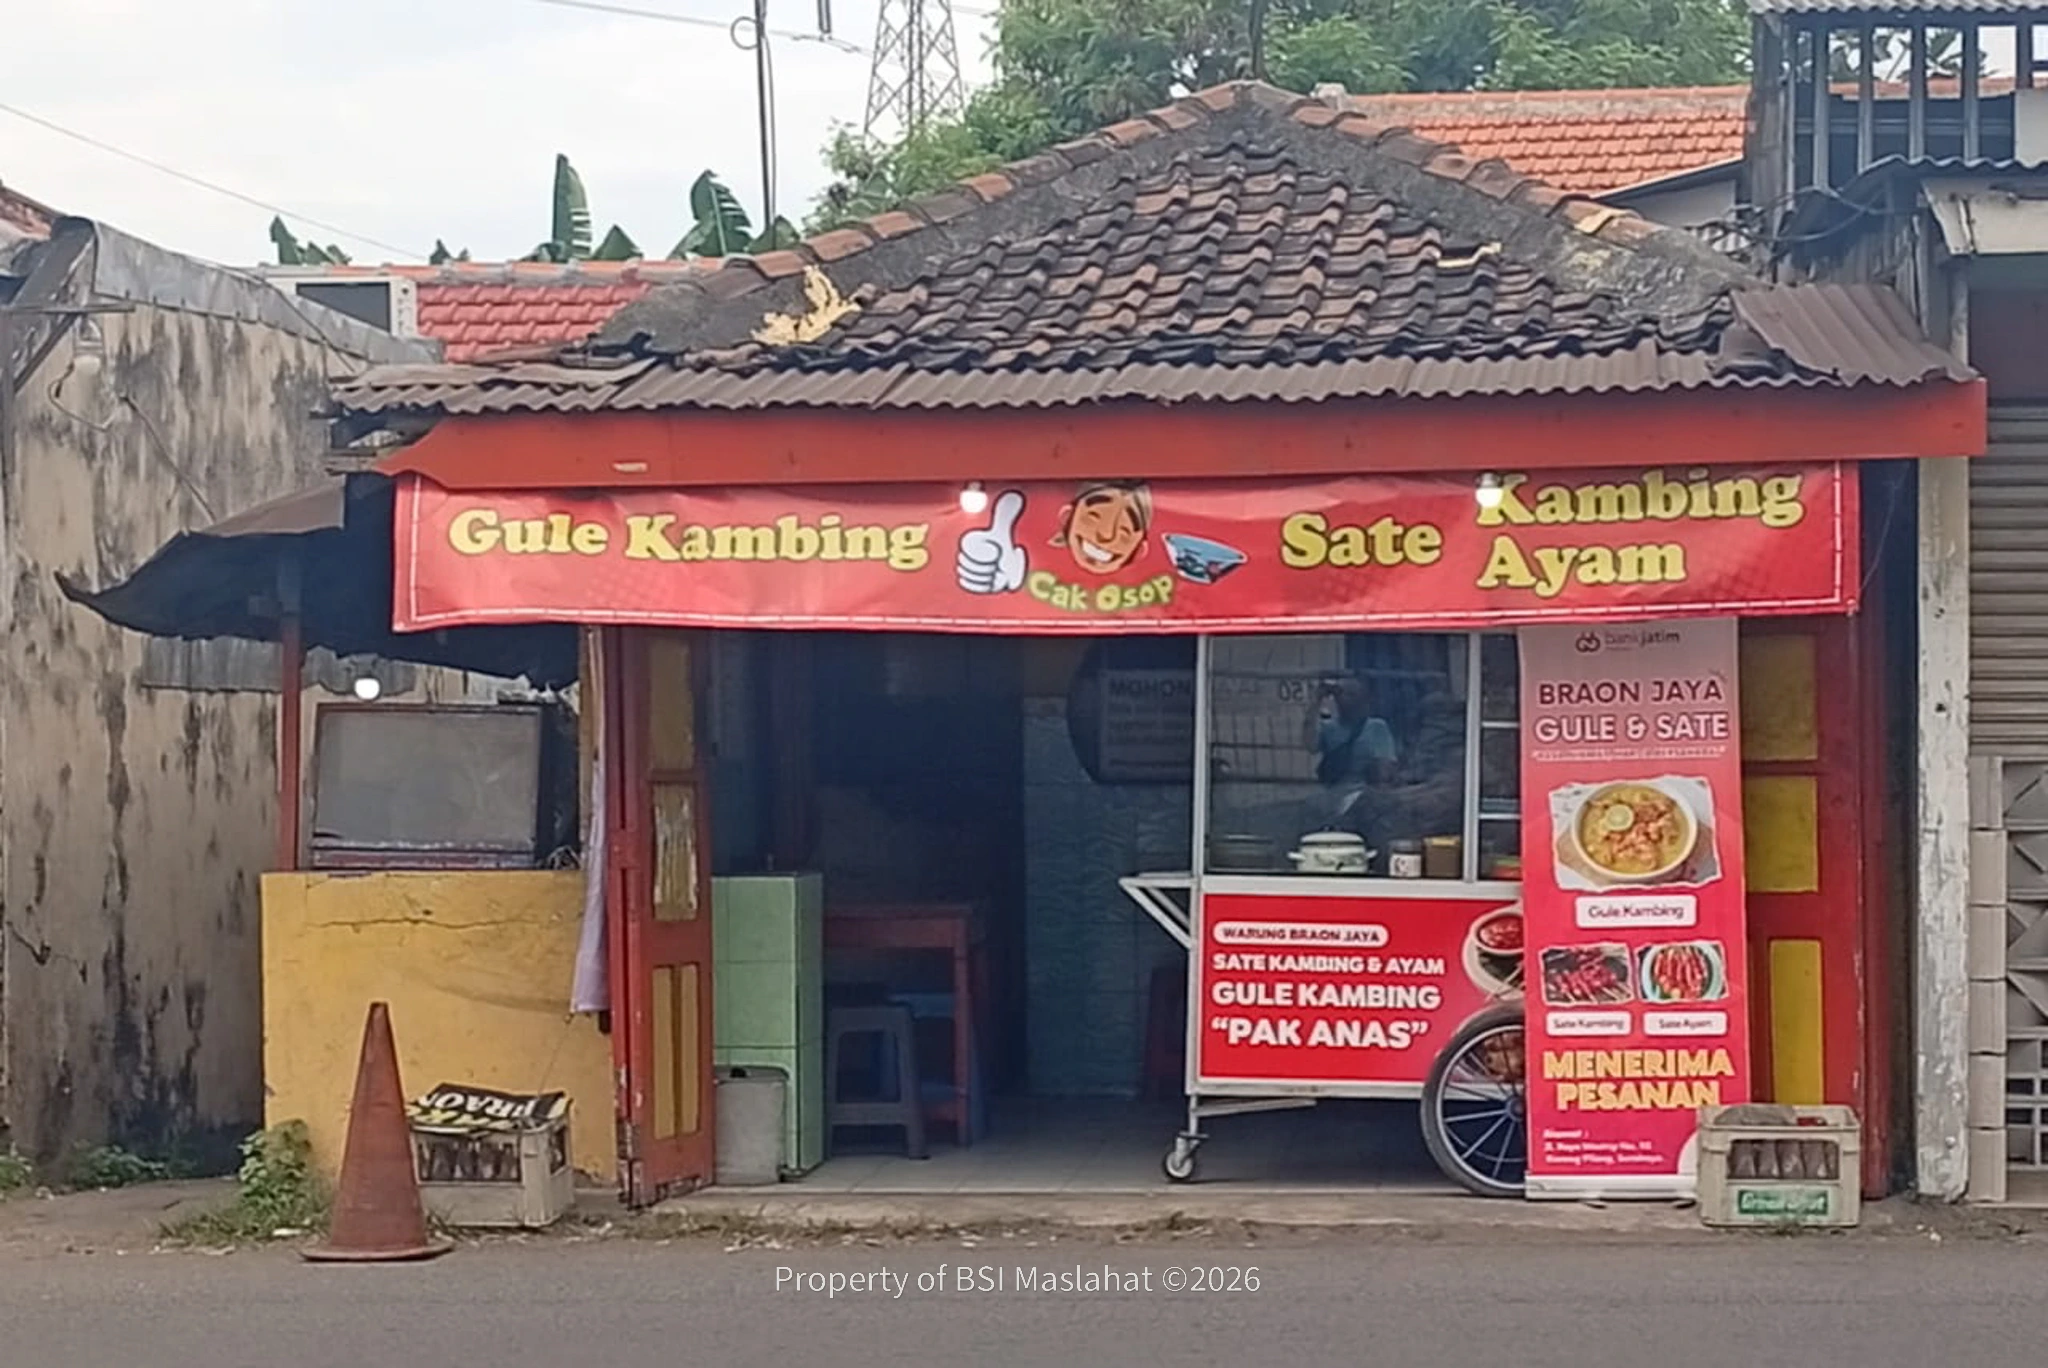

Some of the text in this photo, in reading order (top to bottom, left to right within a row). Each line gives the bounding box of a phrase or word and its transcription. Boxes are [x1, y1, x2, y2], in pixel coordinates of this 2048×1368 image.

[1476, 469, 1804, 527] Kambing
[448, 508, 930, 571] Gule Kambing
[1281, 512, 1442, 567] Sate
[1477, 535, 1687, 596] Ayam
[1026, 569, 1177, 612] Cak Osop
[1539, 679, 1722, 705] BRAON JAYA
[1534, 711, 1729, 743] GULE & SATE
[1223, 927, 1380, 942] WARUNG BRAON JAYA
[1212, 953, 1445, 975] SATE KAMBING & AYAM
[1212, 982, 1441, 1010] GULE KAMBING
[1542, 1049, 1735, 1079] MENERIMA
[1556, 1081, 1720, 1111] PESANAN
